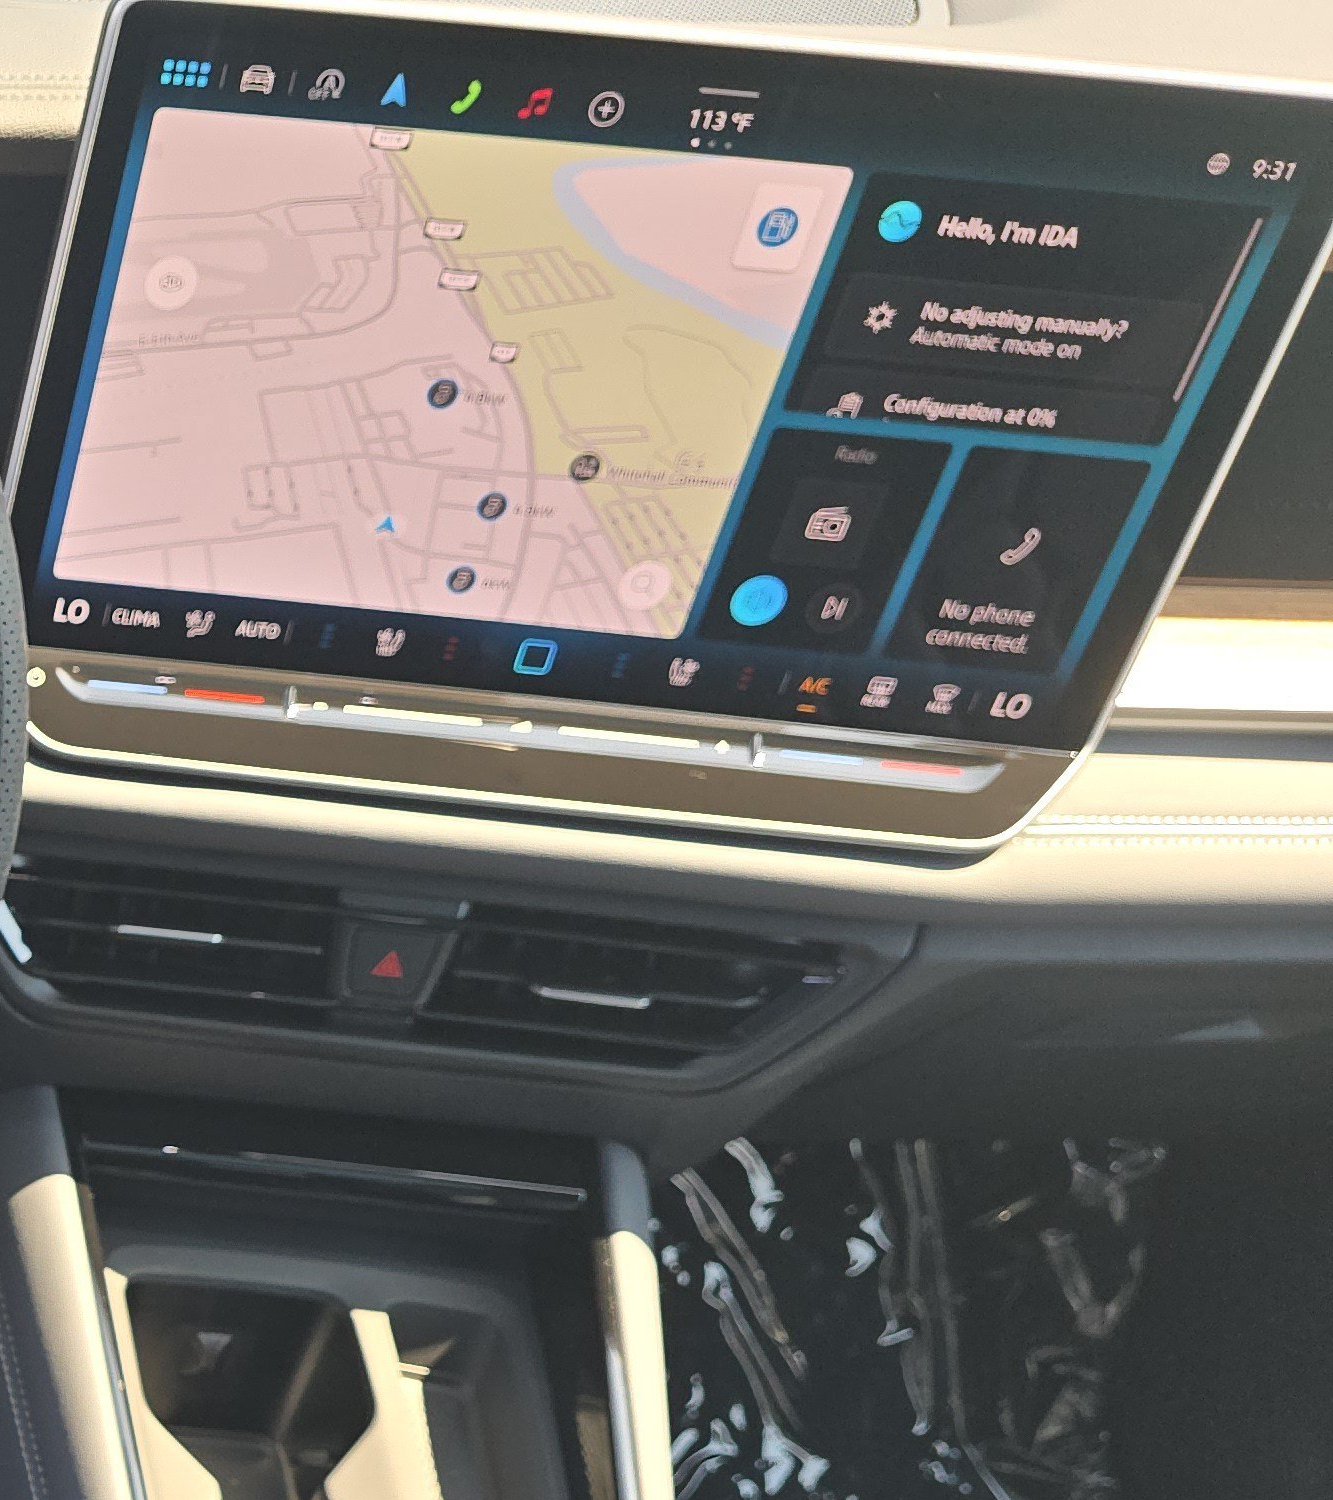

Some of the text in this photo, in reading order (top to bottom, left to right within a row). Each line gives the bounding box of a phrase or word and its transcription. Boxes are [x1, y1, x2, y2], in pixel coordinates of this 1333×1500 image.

[1252, 159, 1297, 181] 9:31
[936, 214, 1079, 248] Hello, I'm IDA
[920, 301, 1129, 343] No adjusting manually?
[908, 326, 1082, 360] Automatic mode on
[883, 393, 1059, 429] Configuration at 0%
[835, 444, 878, 465] Radio
[53, 597, 282, 640] LO CLIMA AUTO
[938, 598, 1036, 627] No phone
[925, 628, 1030, 655] connected.
[798, 676, 833, 696] A/C
[989, 691, 1033, 719] LO
